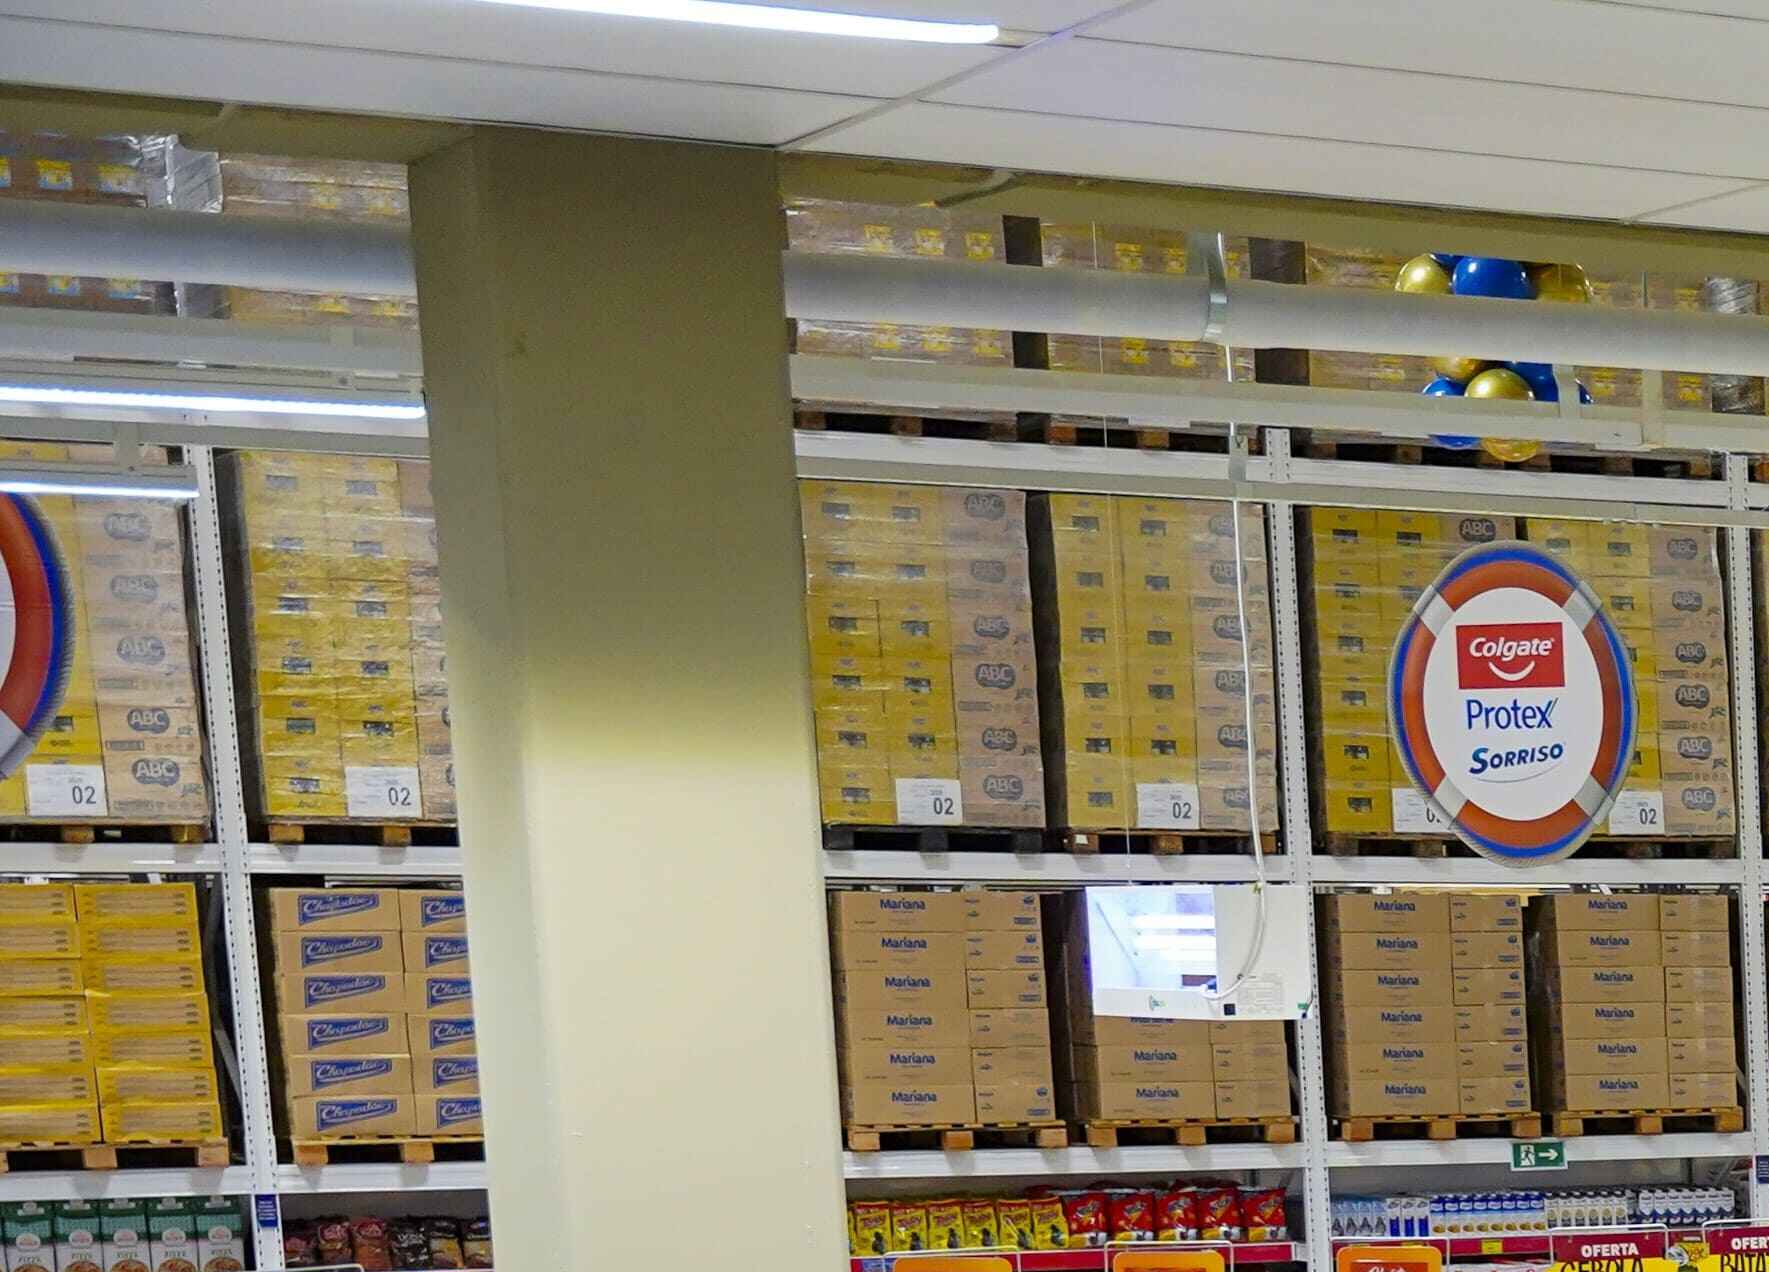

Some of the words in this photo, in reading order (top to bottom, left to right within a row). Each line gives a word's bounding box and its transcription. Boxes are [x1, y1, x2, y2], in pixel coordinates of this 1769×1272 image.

[1470, 637, 1553, 661] Colgate
[131, 712, 164, 726] ABC
[1467, 697, 1558, 729] Protex
[72, 786, 96, 804] 02
[388, 788, 411, 806] 02
[933, 798, 954, 815] 02
[880, 898, 925, 910] Mariana
[882, 937, 927, 949] Mariana
[1581, 1243, 1639, 1257] OFERTA
